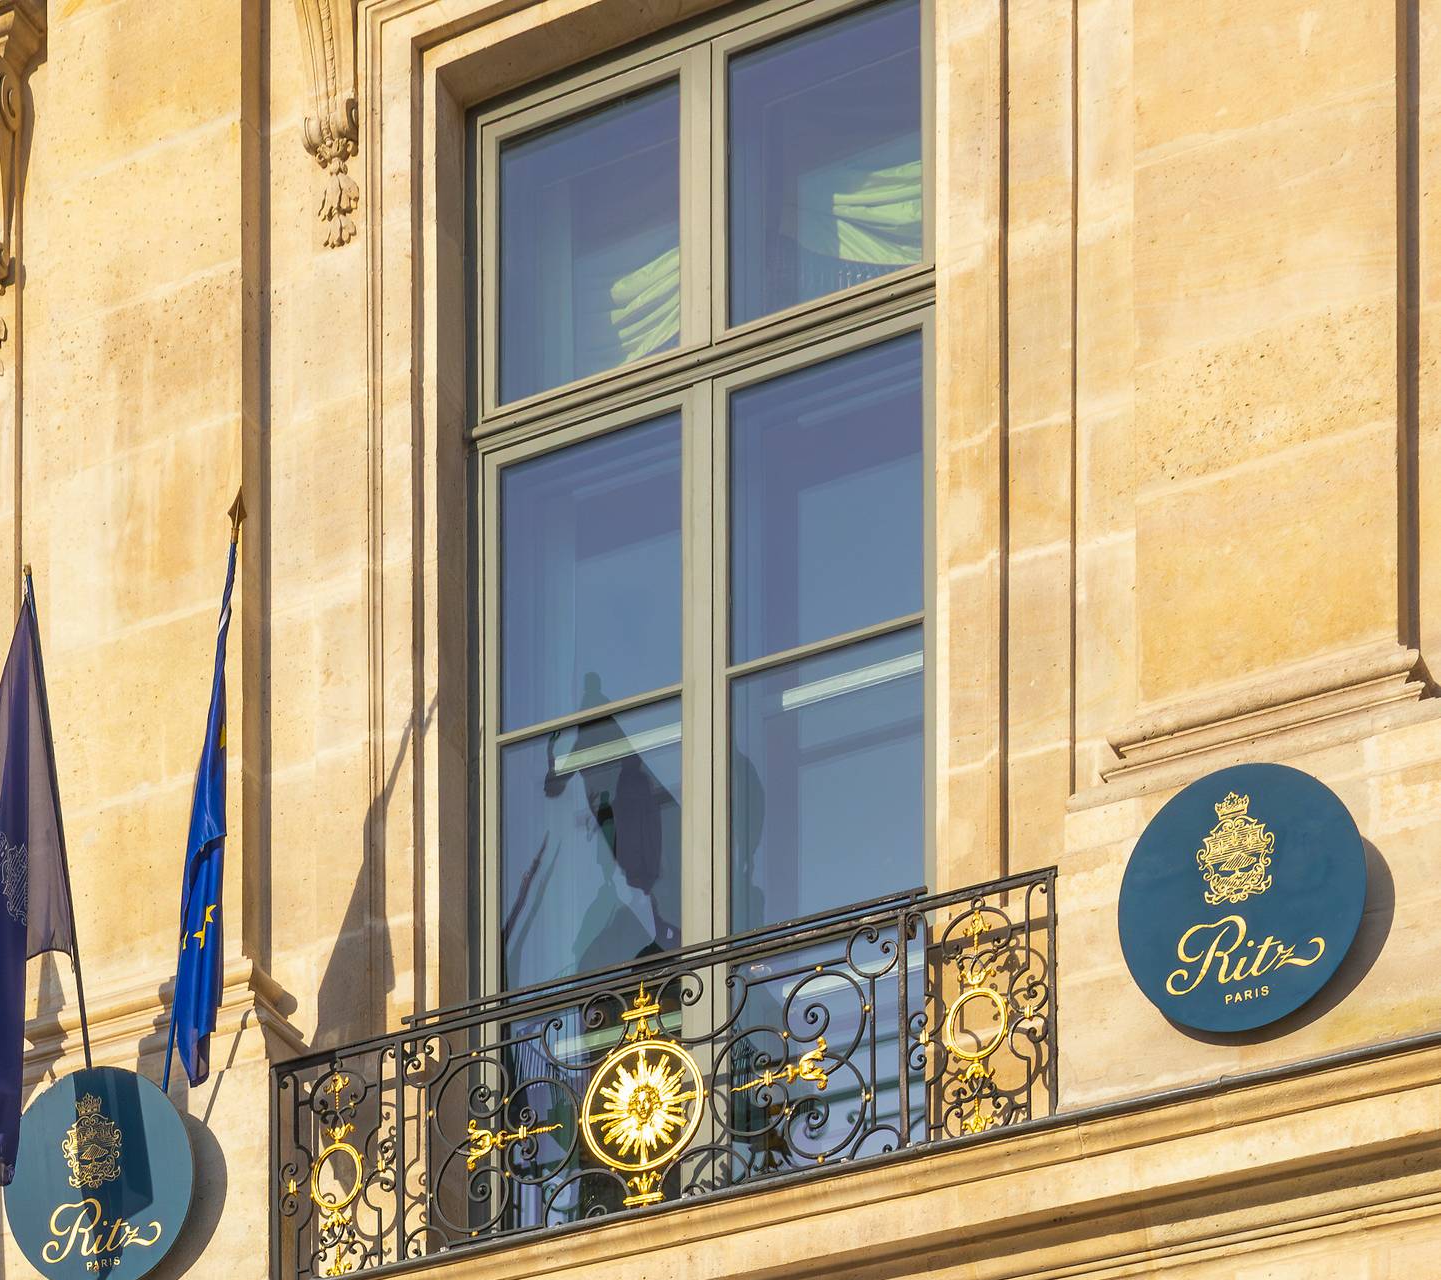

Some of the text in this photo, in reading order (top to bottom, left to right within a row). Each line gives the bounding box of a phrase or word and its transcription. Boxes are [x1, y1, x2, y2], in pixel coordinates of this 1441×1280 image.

[1166, 914, 1326, 996] Ritz
[1224, 985, 1271, 1005] PARIS
[42, 1197, 162, 1264] Ritz
[85, 1256, 121, 1272] PARIS
